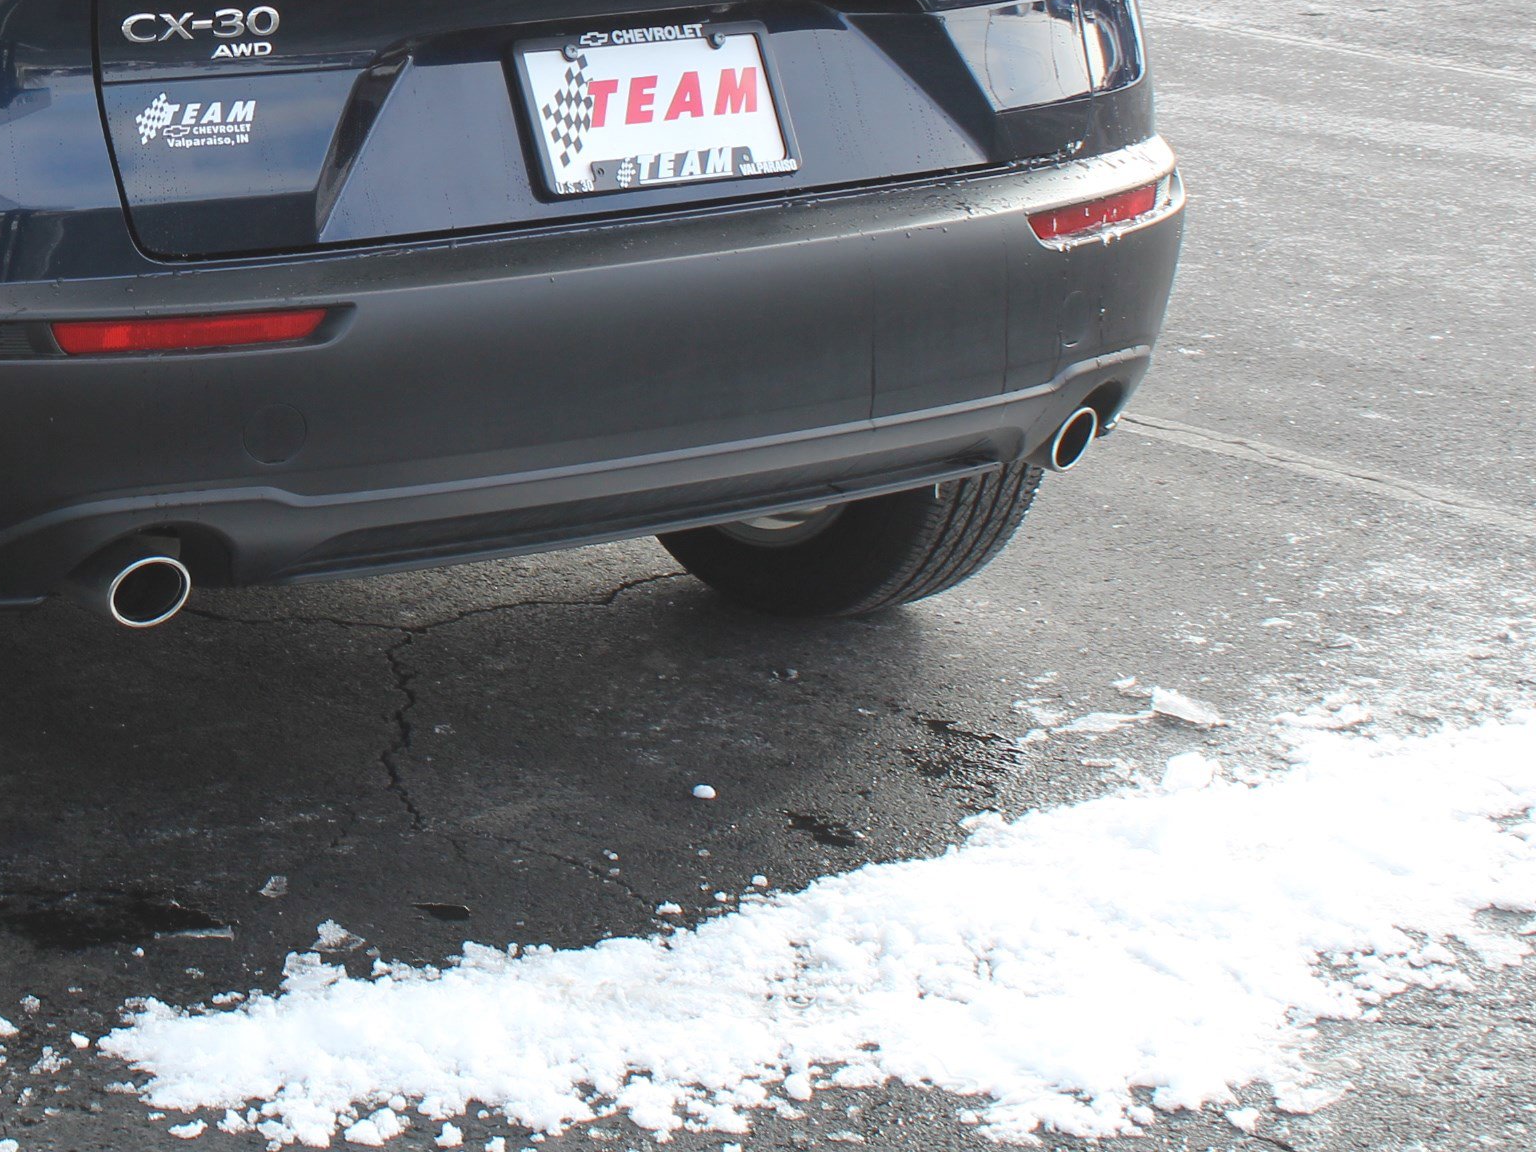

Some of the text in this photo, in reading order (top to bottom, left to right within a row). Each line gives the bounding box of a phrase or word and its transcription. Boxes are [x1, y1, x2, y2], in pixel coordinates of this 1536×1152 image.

[122, 6, 280, 43] CX-30
[612, 24, 703, 45] CHEVROLET
[211, 42, 272, 59] AWD
[587, 67, 757, 128] TEAM
[163, 100, 256, 125] TEAM
[193, 124, 251, 135] CHEVROLET
[167, 134, 249, 148] Valparaiso, IN
[637, 146, 733, 180] TEAM
[739, 159, 797, 176] VALPARAISO
[555, 179, 594, 195] U.S. 30
